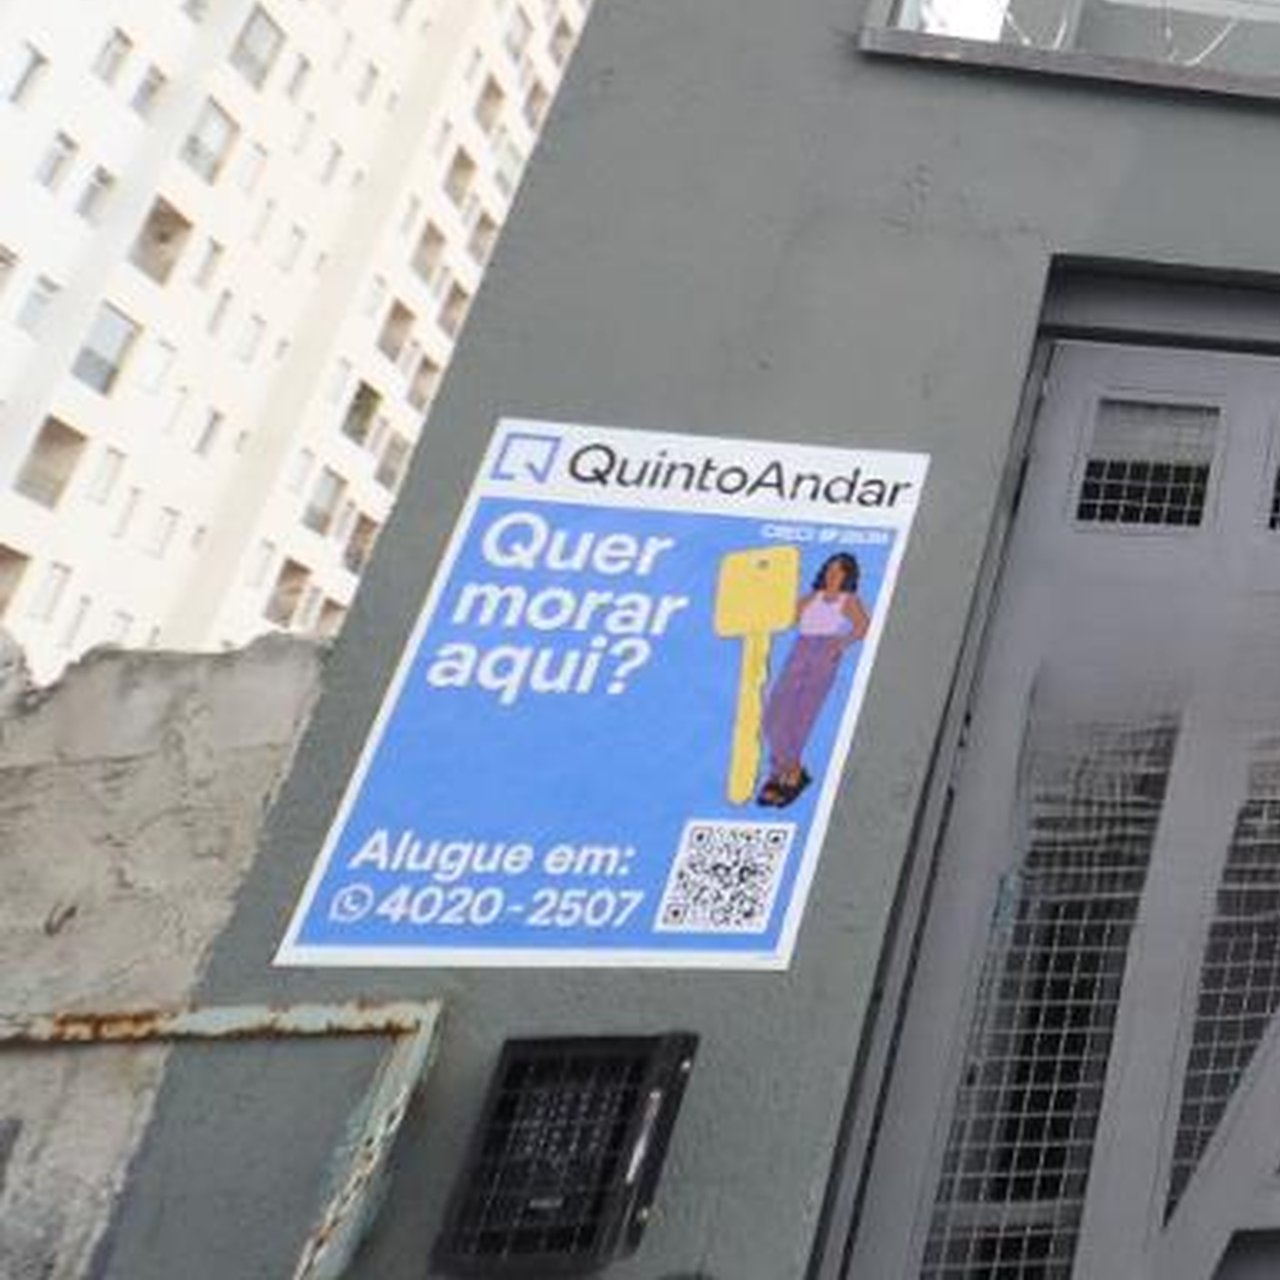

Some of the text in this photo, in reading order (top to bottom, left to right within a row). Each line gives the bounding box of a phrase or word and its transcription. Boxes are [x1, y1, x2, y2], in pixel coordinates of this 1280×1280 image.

[567, 443, 912, 508] QuintoAndar
[482, 511, 673, 575] Quer
[452, 583, 687, 635] morar
[427, 638, 650, 705] aqui?
[350, 829, 635, 882] Alugue em:
